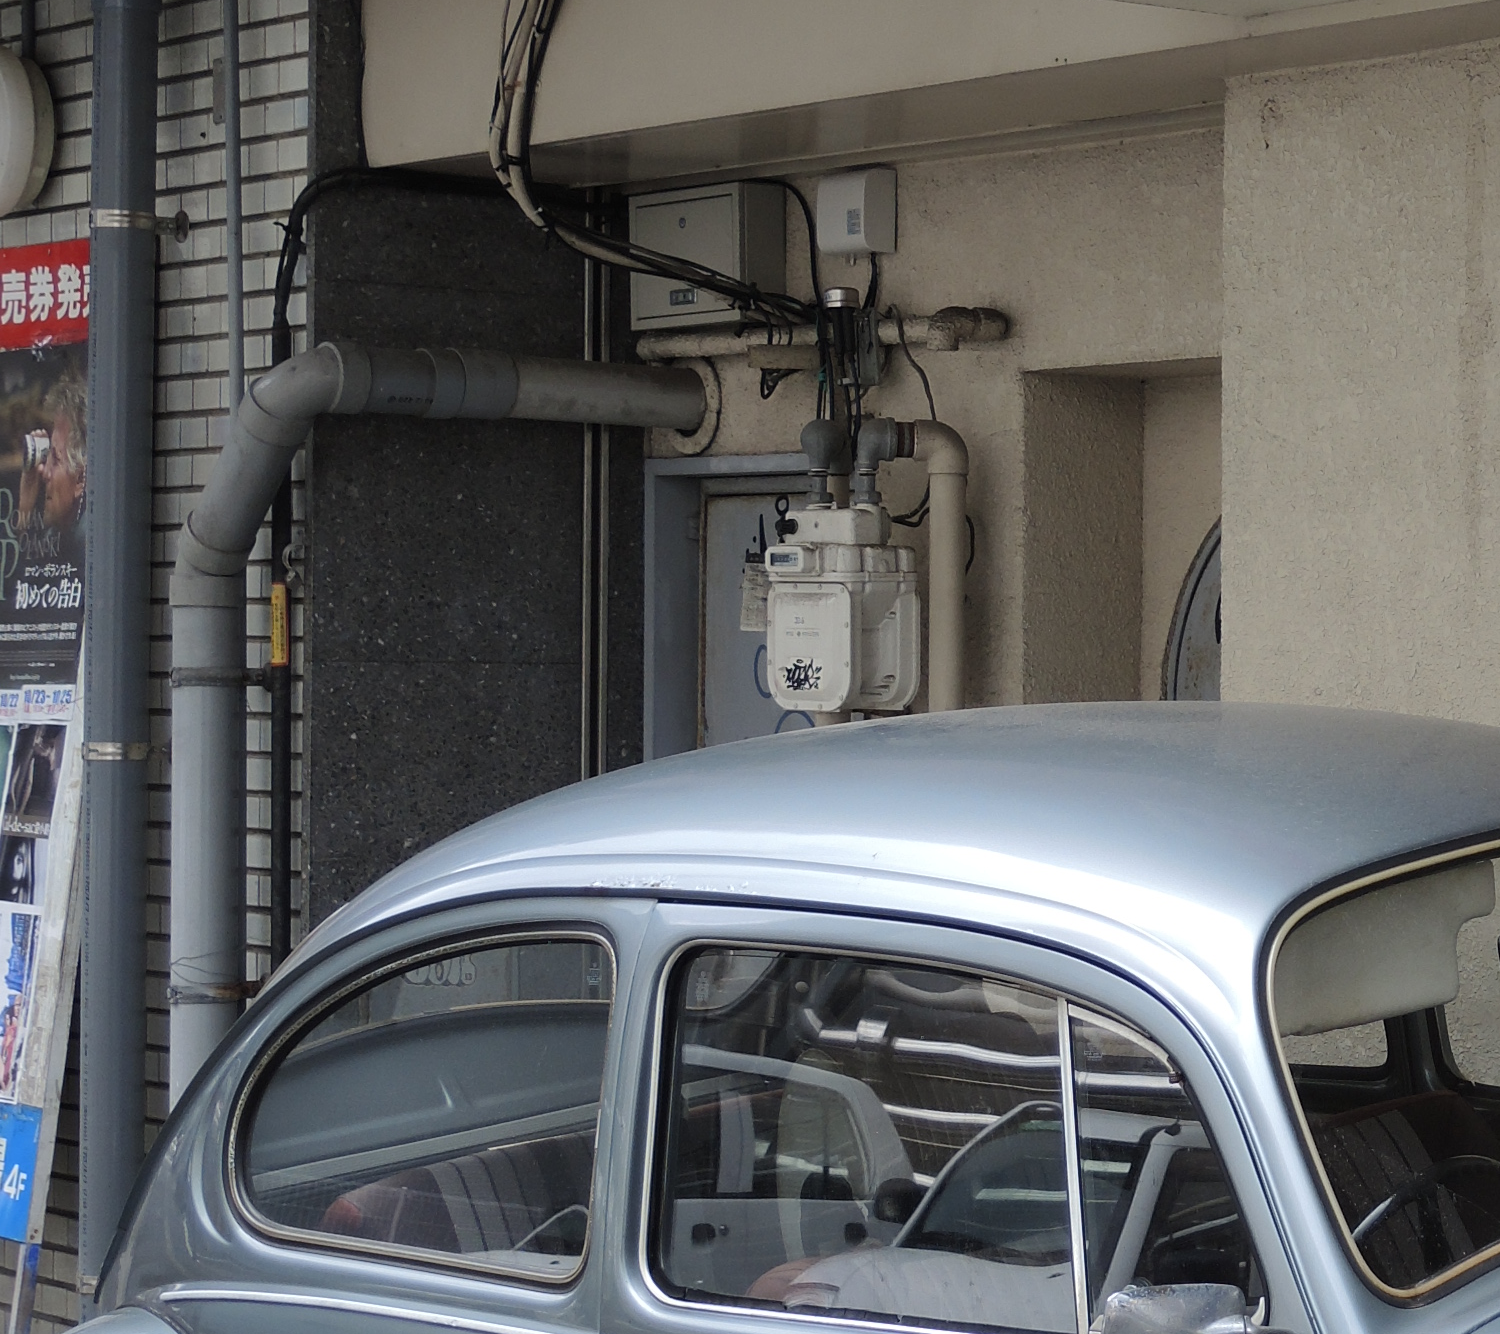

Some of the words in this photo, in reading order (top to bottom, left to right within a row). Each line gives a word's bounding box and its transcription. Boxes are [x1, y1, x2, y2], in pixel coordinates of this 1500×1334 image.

[0, 263, 90, 324] 売券発
[15, 578, 82, 610] 初めての告白
[3, 1163, 28, 1201] 4F
